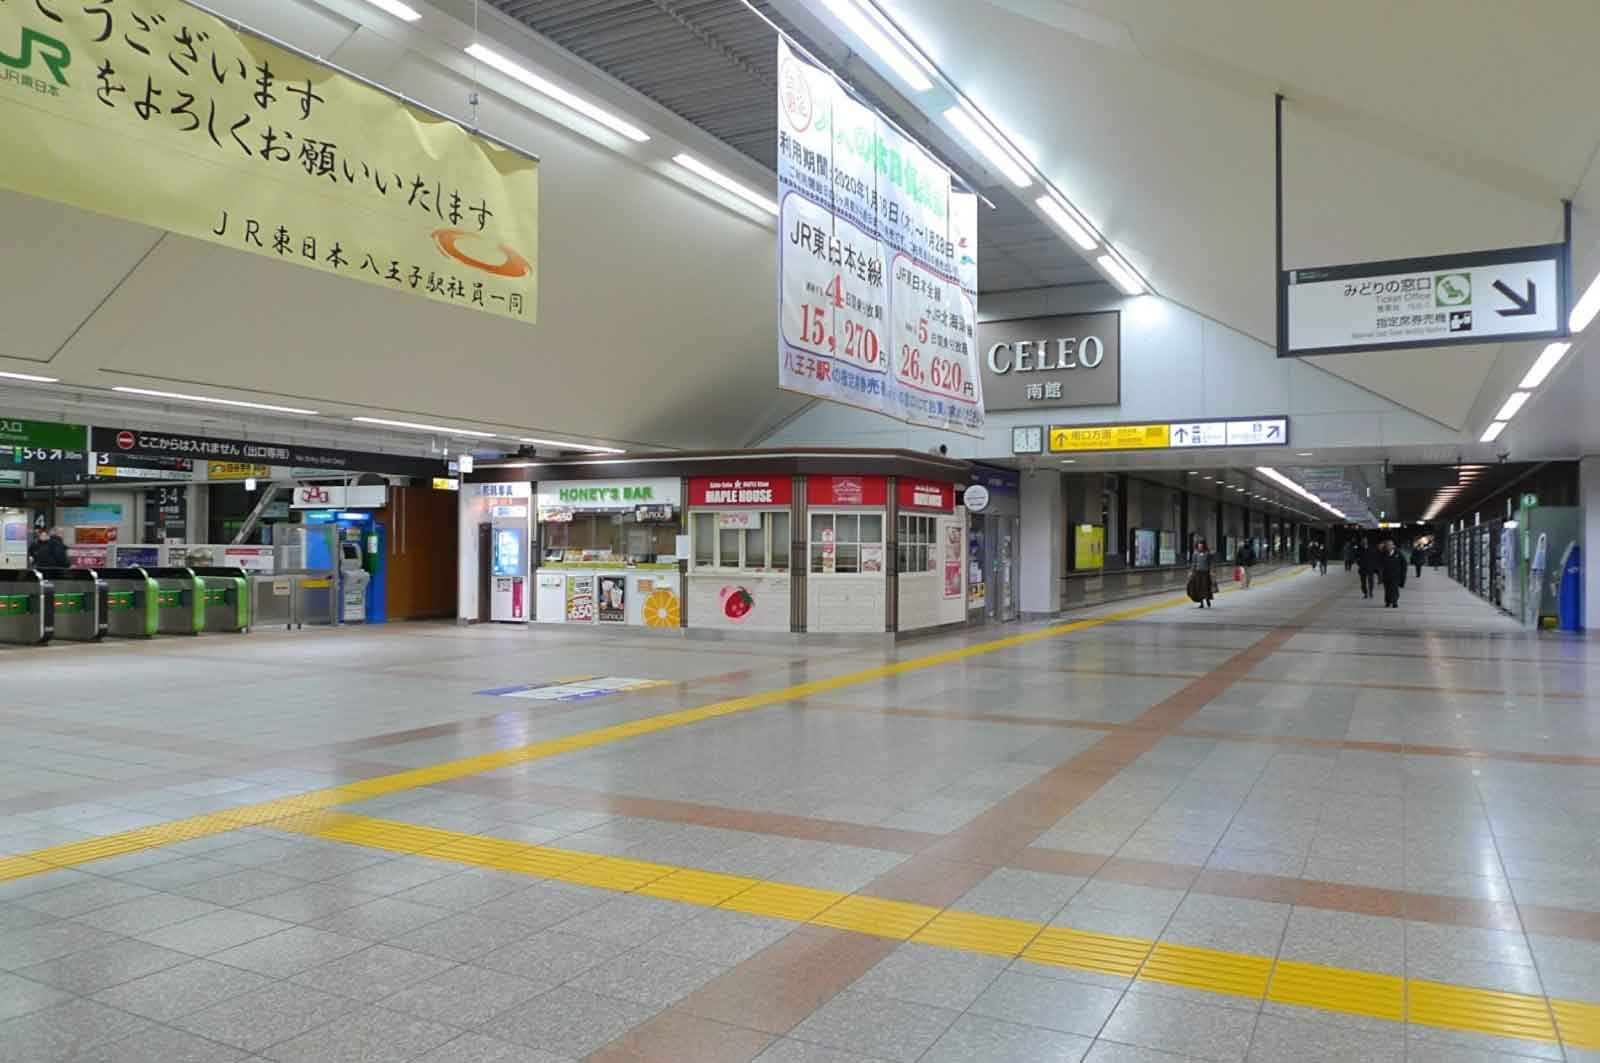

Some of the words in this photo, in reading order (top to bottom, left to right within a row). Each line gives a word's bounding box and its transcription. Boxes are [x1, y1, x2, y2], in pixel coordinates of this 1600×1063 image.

[96, 59, 495, 231] をよろしくお願いいたします
[790, 220, 883, 288] JR東日本全線
[359, 253, 524, 315] 八王子駅社員一同
[1343, 277, 1431, 297] みどりの窓口
[988, 336, 1105, 374] CELEO
[1025, 382, 1063, 400] 南館
[559, 487, 620, 501] HONEY'S
[623, 486, 654, 499] BAR
[705, 489, 737, 503] MAPLE
[739, 489, 773, 503] HOUSE
